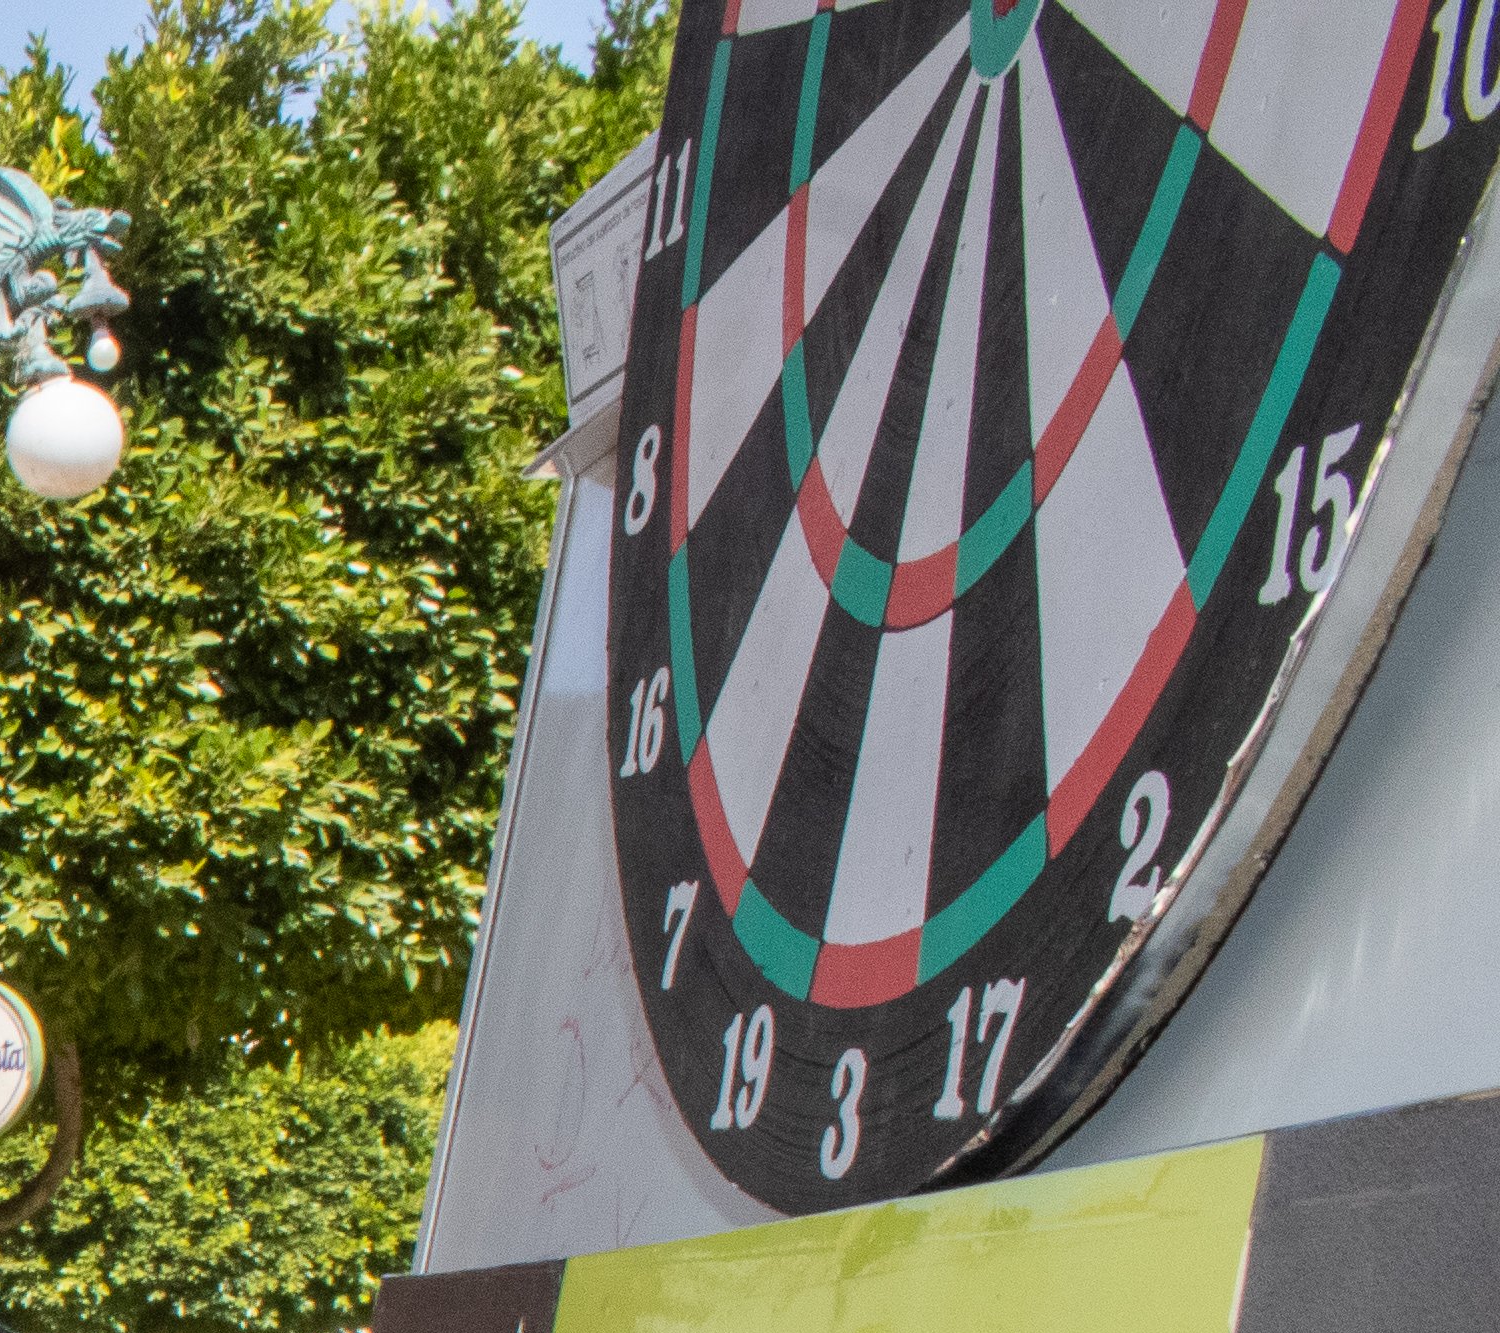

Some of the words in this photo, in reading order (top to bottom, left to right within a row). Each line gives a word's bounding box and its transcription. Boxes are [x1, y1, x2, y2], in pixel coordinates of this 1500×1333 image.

[645, 138, 691, 262] 11
[625, 424, 662, 536] 8
[1258, 423, 1361, 605] 15
[620, 666, 670, 778] 16
[1108, 770, 1172, 923] 2
[661, 879, 699, 991] 7
[710, 1004, 776, 1131] 19
[933, 977, 1026, 1121] 17
[819, 1048, 868, 1180] 3
